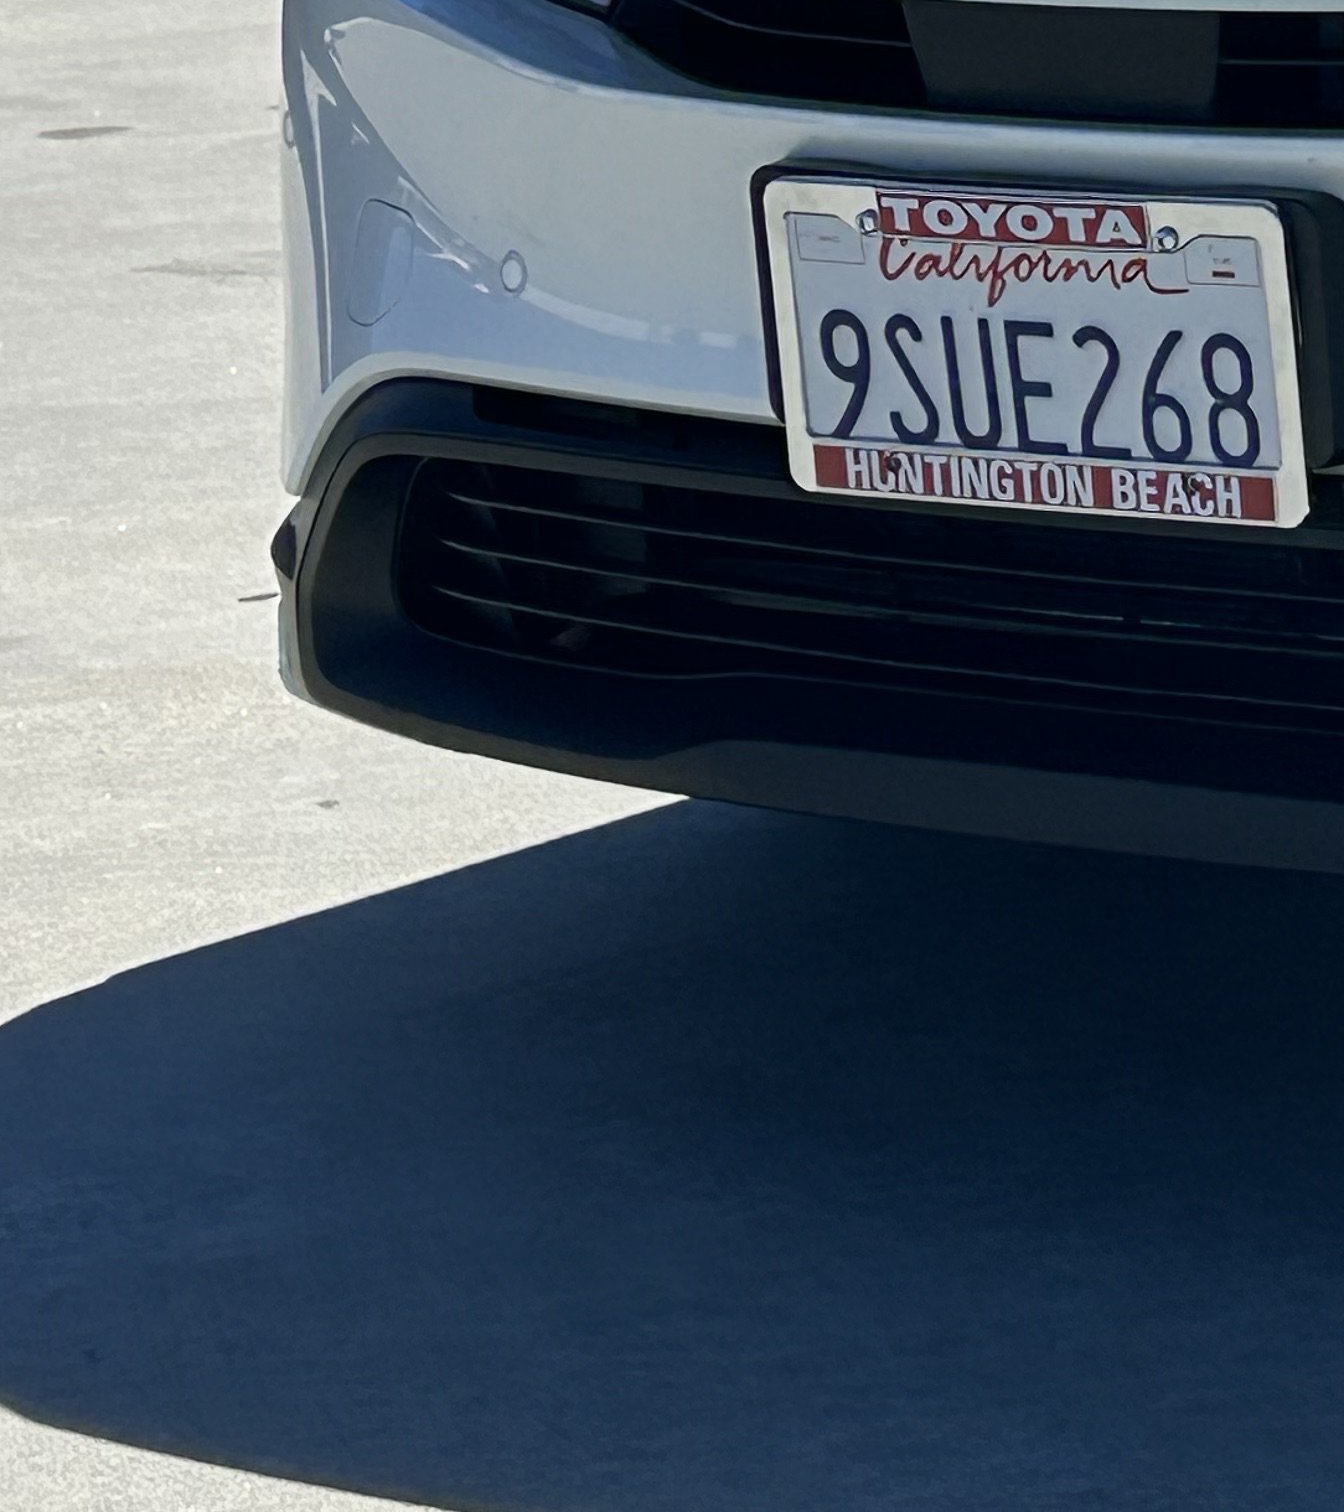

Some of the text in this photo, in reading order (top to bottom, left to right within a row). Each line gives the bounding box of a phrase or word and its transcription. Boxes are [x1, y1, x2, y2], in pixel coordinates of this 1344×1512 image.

[880, 196, 1142, 245] TOYOTA
[879, 238, 1190, 307] California
[819, 308, 1261, 466] 9SUE268
[845, 449, 1242, 520] HUNTINGTON BEACH
